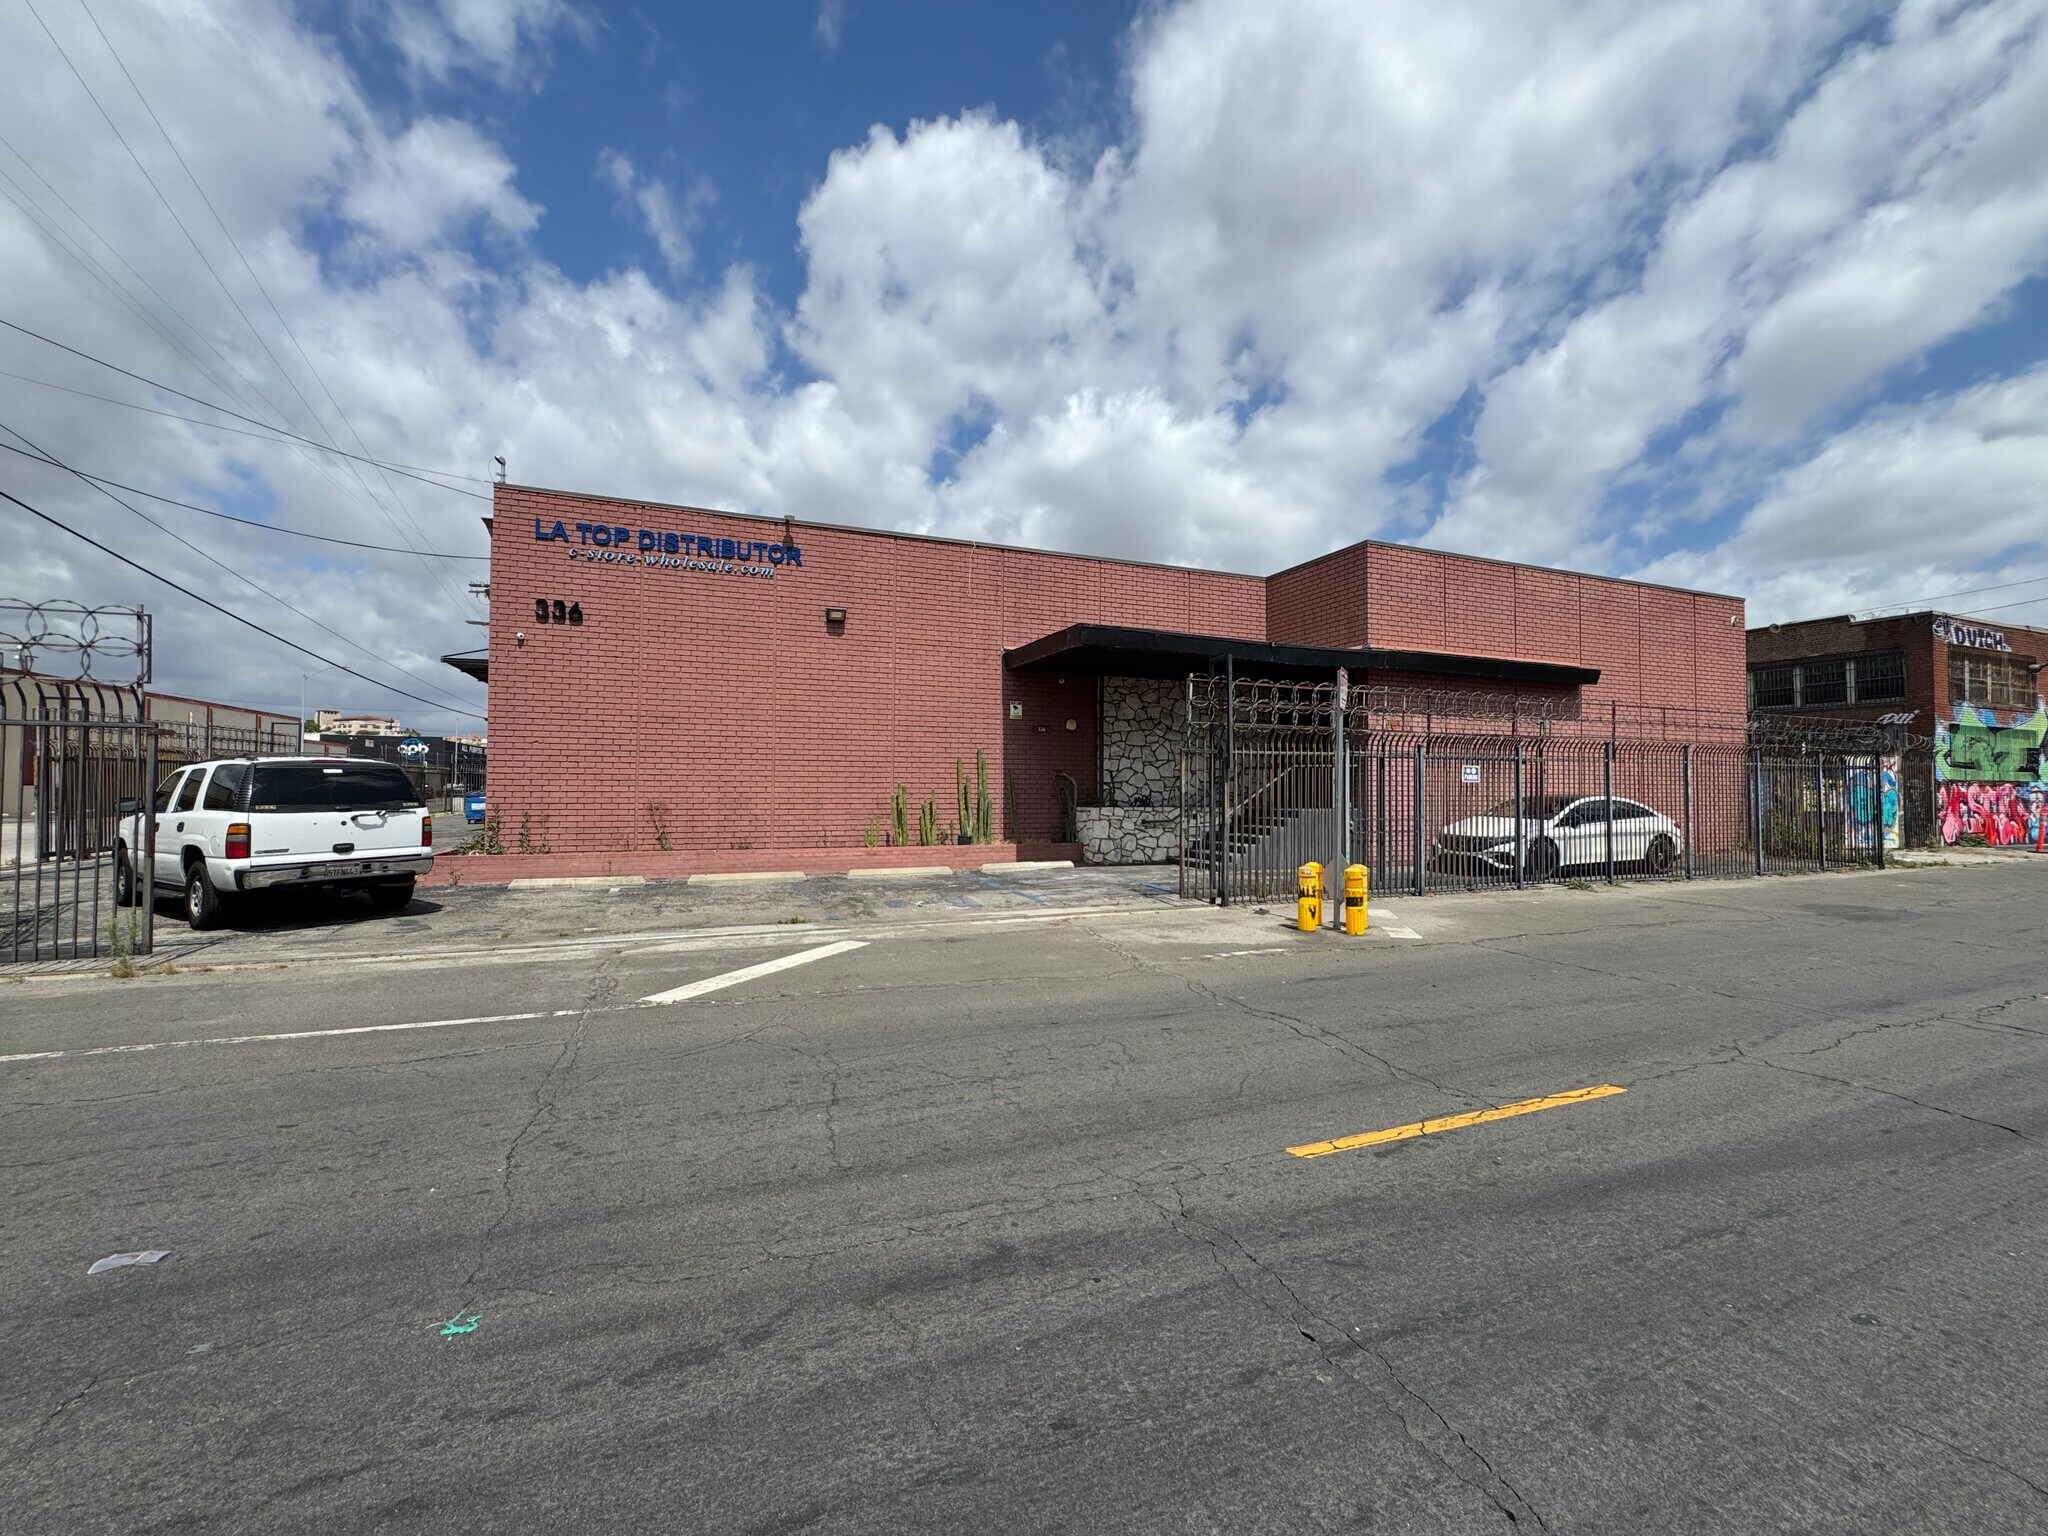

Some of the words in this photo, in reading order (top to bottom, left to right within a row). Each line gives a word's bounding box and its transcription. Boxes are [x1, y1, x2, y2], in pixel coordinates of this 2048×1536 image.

[535, 518, 569, 543] LA
[576, 522, 631, 548] TOP
[638, 530, 802, 566] DISTRIBUTOR
[568, 547, 776, 578] c-store-wholesale.com
[535, 598, 583, 626] 336
[1953, 624, 2004, 651] DUTCH
